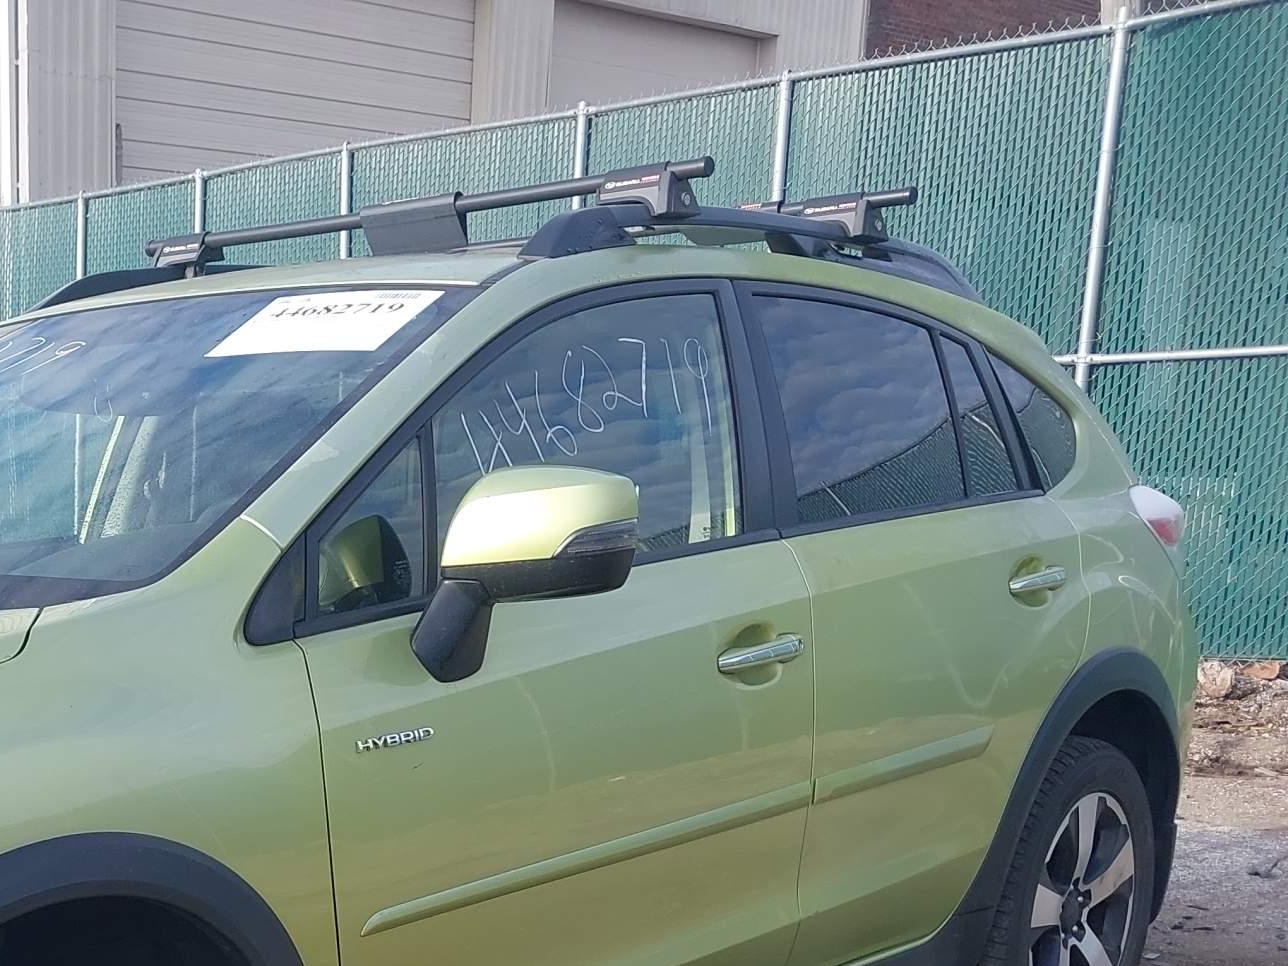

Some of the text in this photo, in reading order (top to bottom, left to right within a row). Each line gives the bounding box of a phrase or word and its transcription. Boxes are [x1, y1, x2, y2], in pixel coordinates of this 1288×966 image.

[270, 302, 405, 318] 44682719
[461, 337, 712, 476] 44682719
[355, 727, 434, 752] HYBRID
